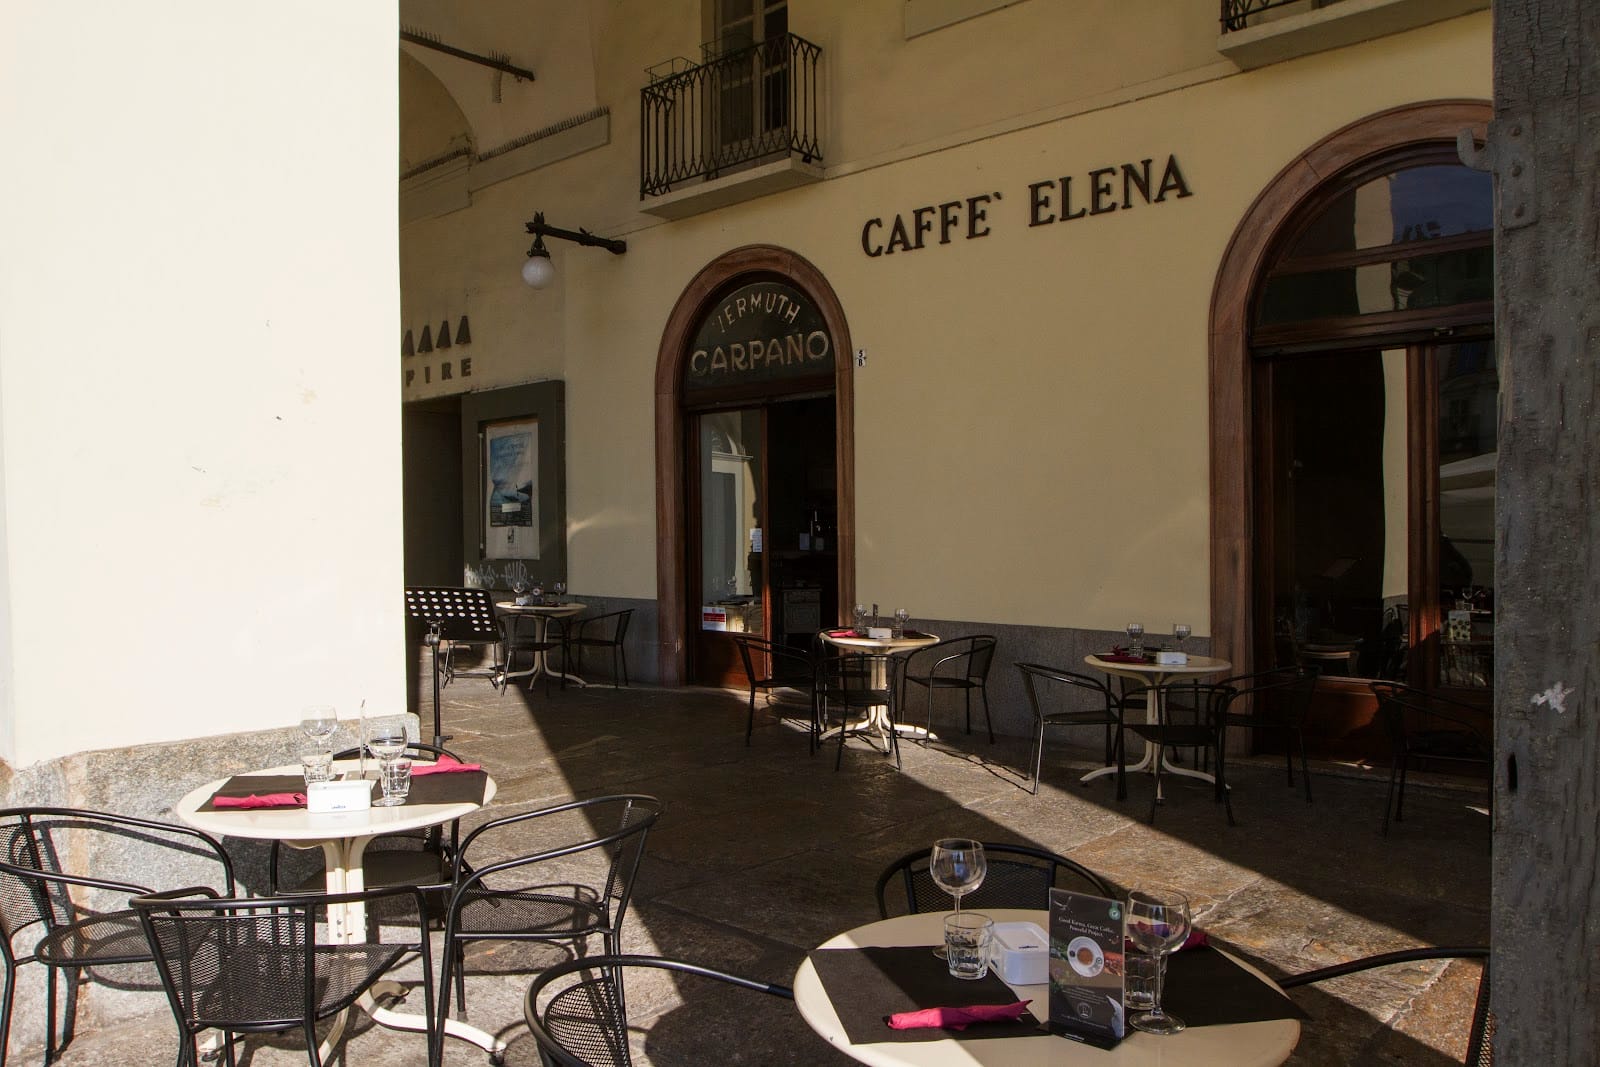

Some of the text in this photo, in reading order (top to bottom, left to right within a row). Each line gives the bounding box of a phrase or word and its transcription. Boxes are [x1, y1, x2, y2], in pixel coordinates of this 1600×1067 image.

[1028, 154, 1193, 227] ELENA
[405, 358, 472, 387] PIRE
[691, 330, 829, 377] CARPANO
